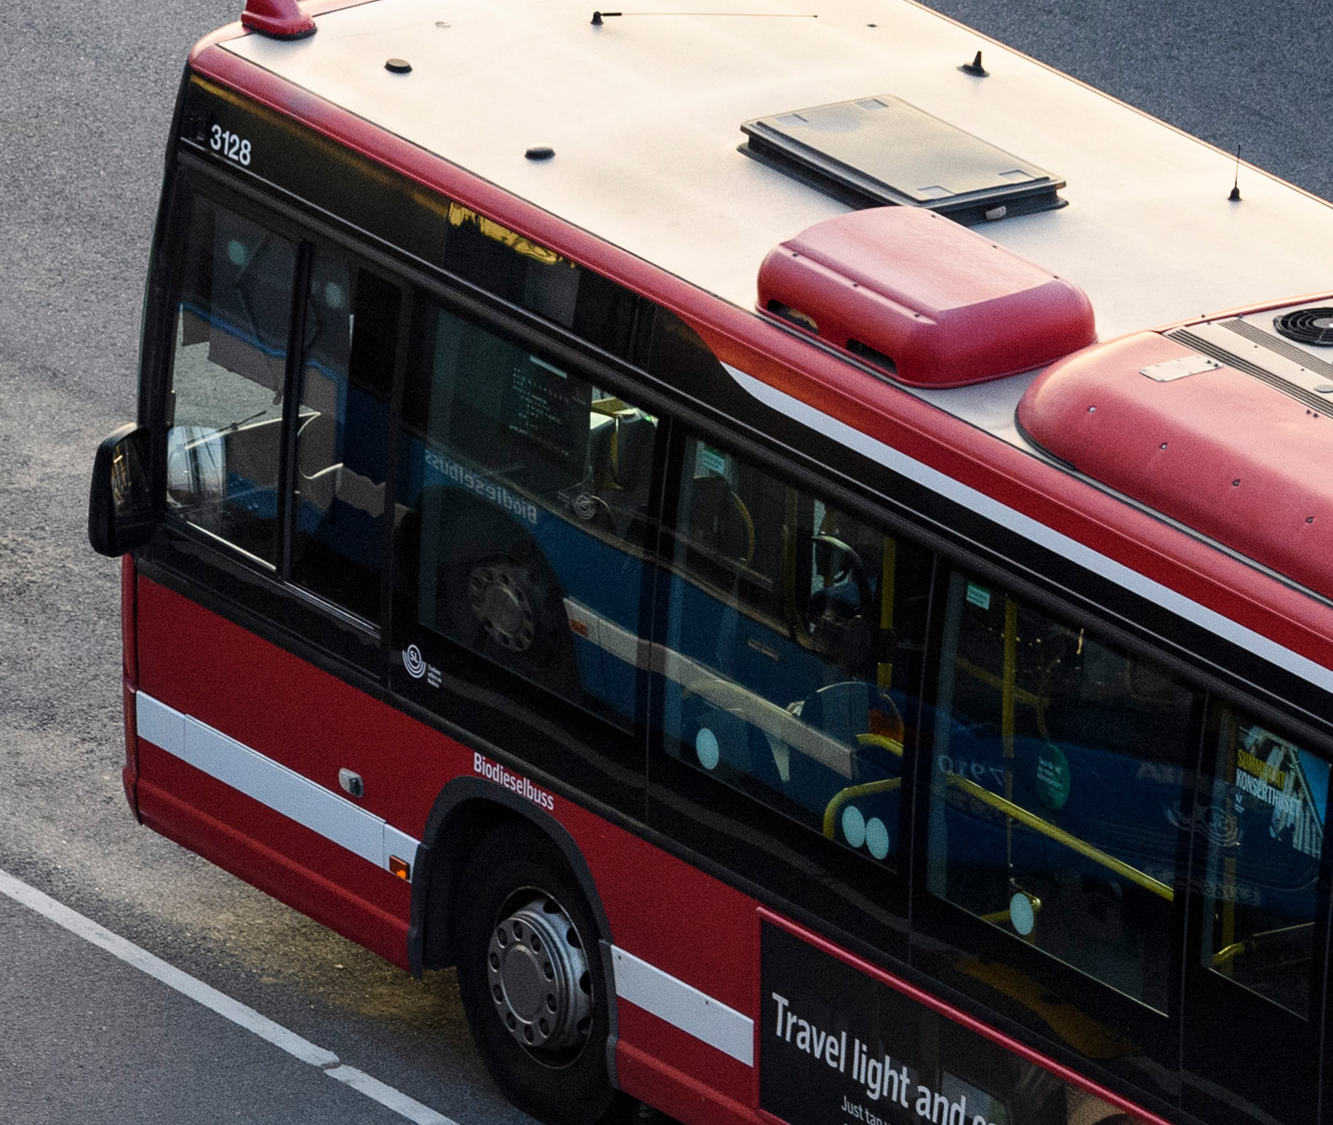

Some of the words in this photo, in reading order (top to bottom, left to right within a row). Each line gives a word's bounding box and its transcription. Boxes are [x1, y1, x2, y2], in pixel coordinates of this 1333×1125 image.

[210, 124, 252, 166] 3128
[473, 751, 555, 811] Biodieselbuss
[772, 992, 848, 1073] Travel
[852, 1038, 911, 1108] light
[915, 1084, 967, 1125] and
[840, 1095, 865, 1121] Just
